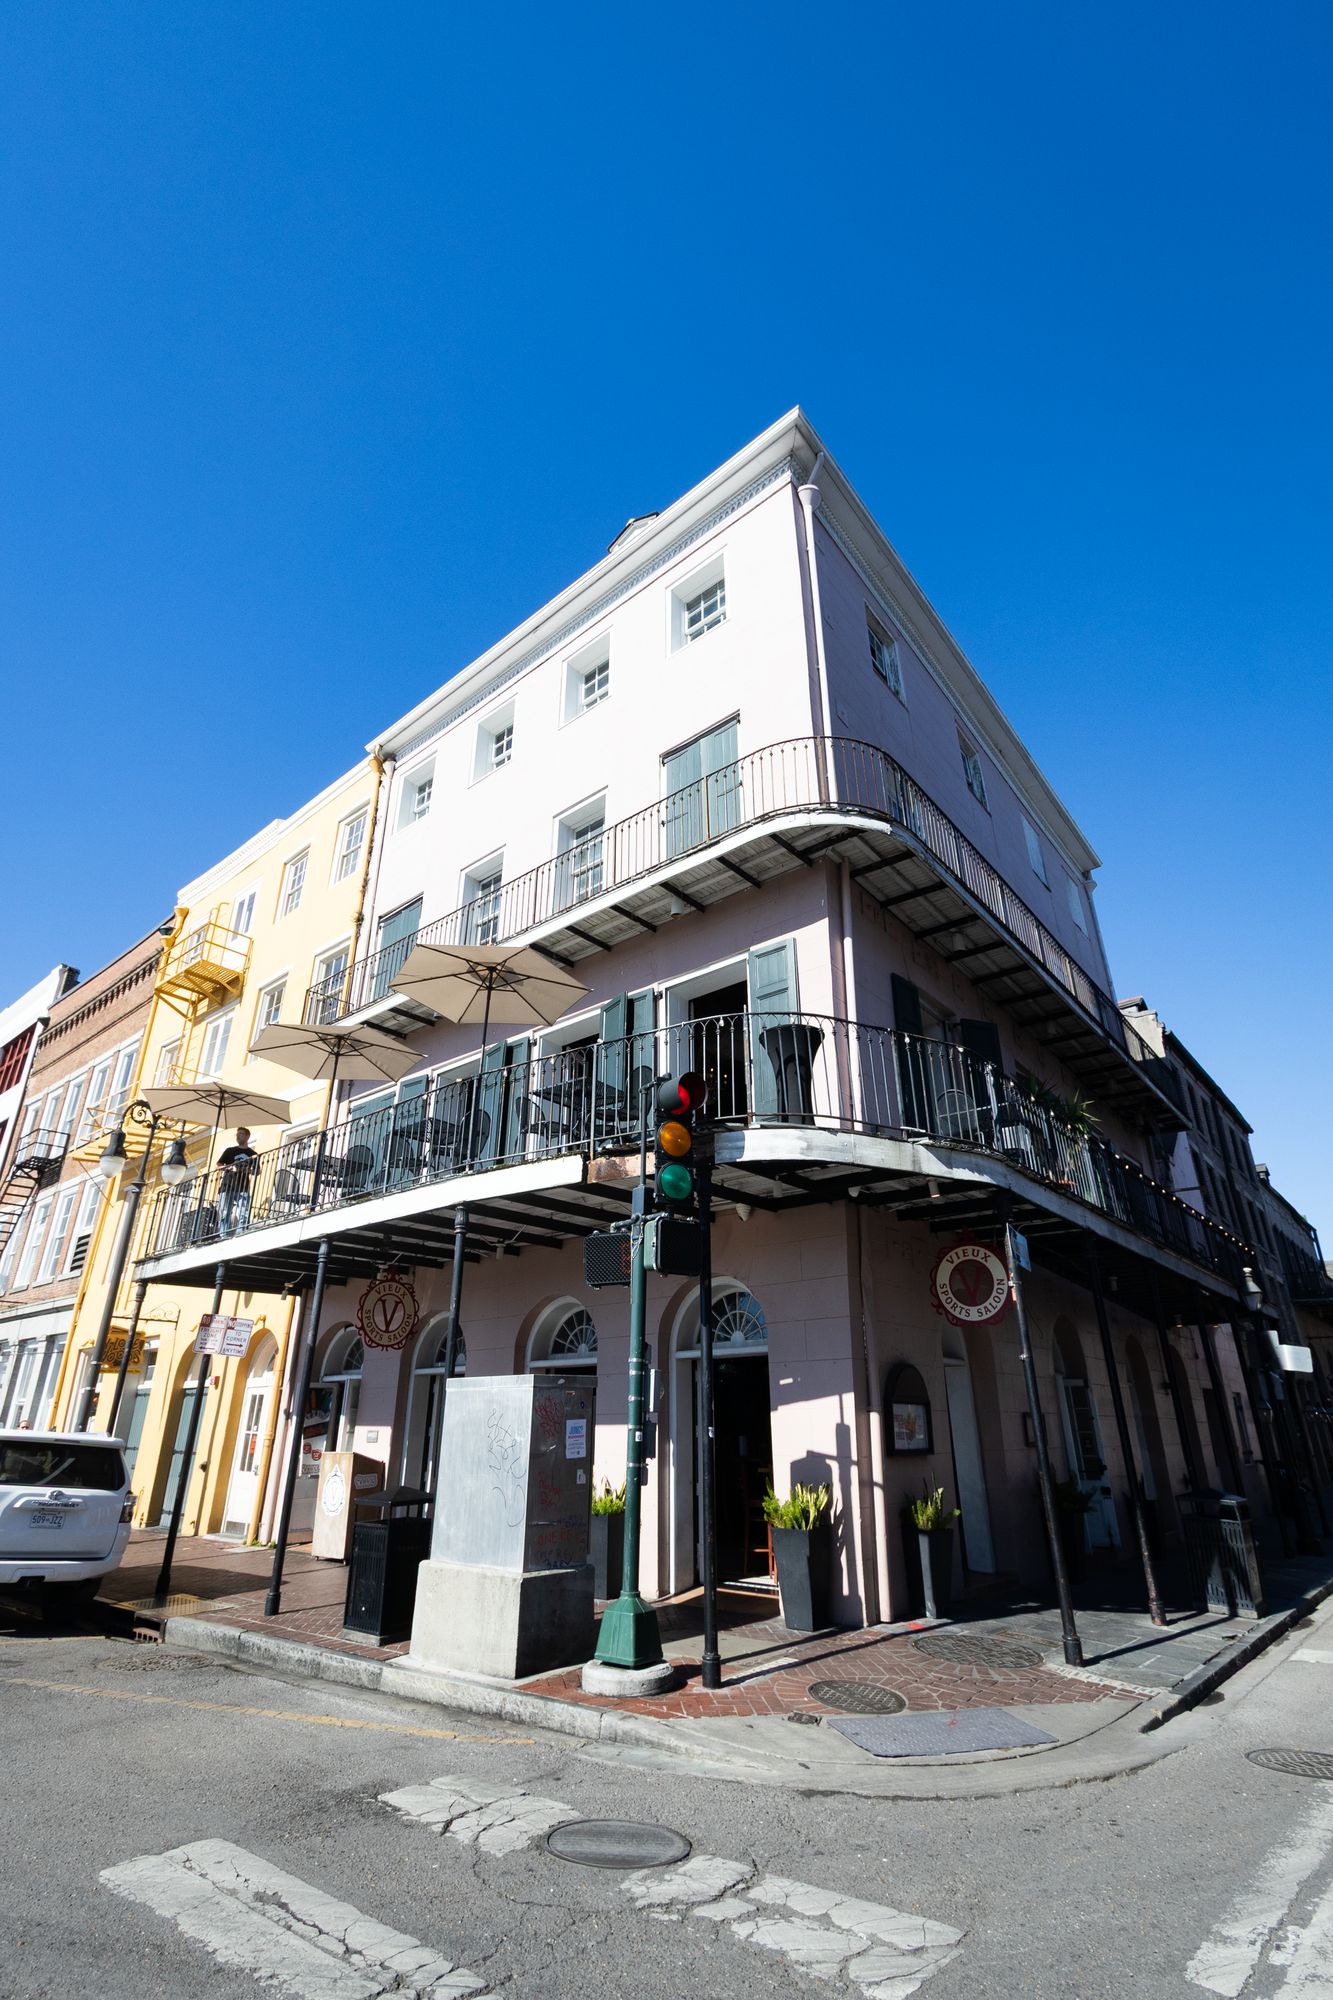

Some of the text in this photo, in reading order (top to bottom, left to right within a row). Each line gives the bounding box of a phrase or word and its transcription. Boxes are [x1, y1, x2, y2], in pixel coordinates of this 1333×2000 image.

[946, 1248, 991, 1264] VIEUX
[375, 1284, 408, 1299] VIEUX
[939, 1278, 1005, 1318] SPORTS SALOON
[365, 1309, 412, 1342] SPORTS SALOON
[380, 1299, 403, 1332] V
